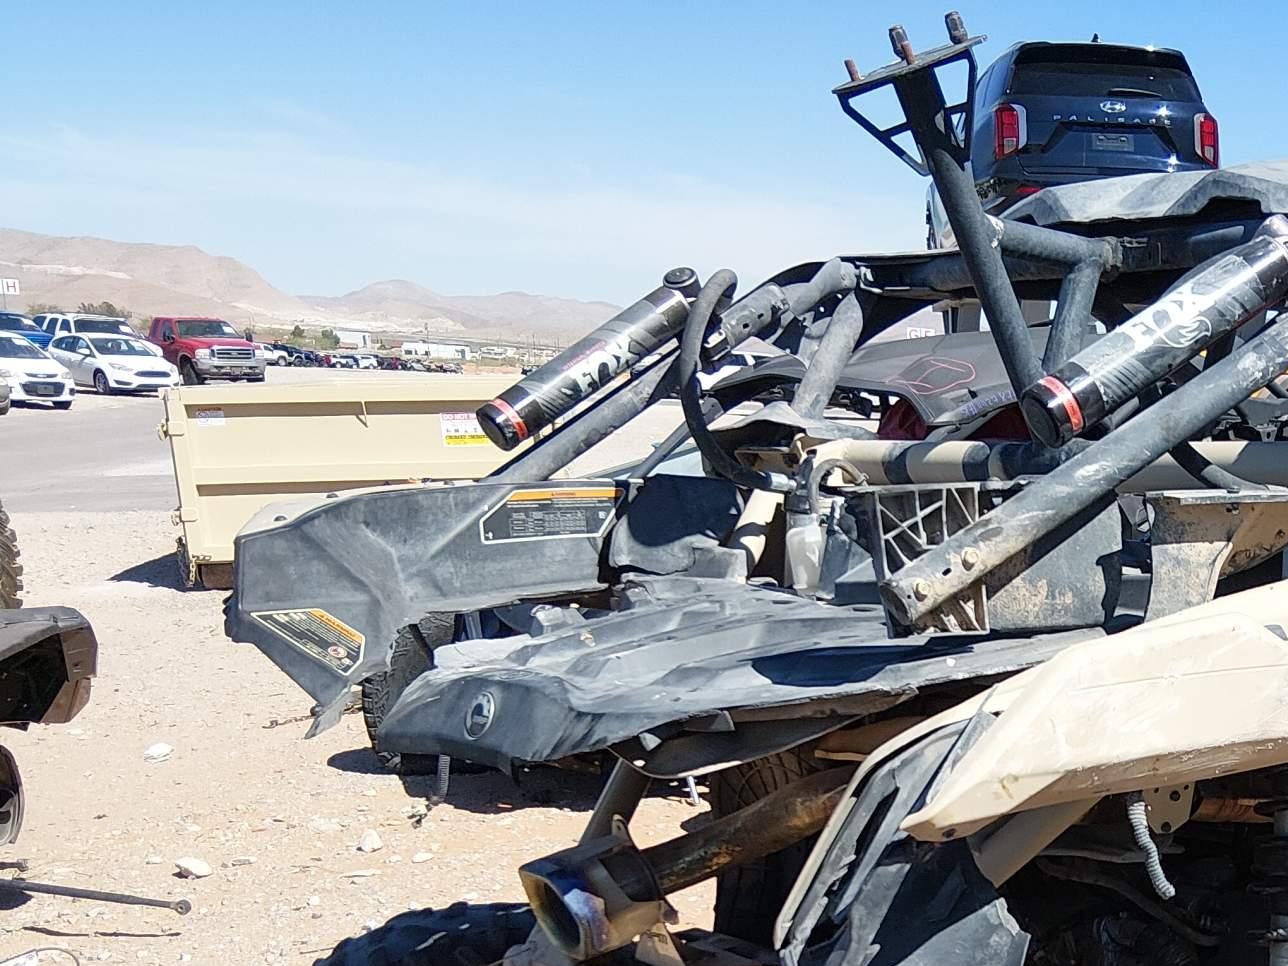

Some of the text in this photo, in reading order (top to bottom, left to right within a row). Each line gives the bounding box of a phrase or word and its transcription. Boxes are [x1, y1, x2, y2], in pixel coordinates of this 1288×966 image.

[1053, 114, 1172, 127] PALISADE
[1118, 283, 1216, 349] FOX
[567, 336, 642, 397] FOX
